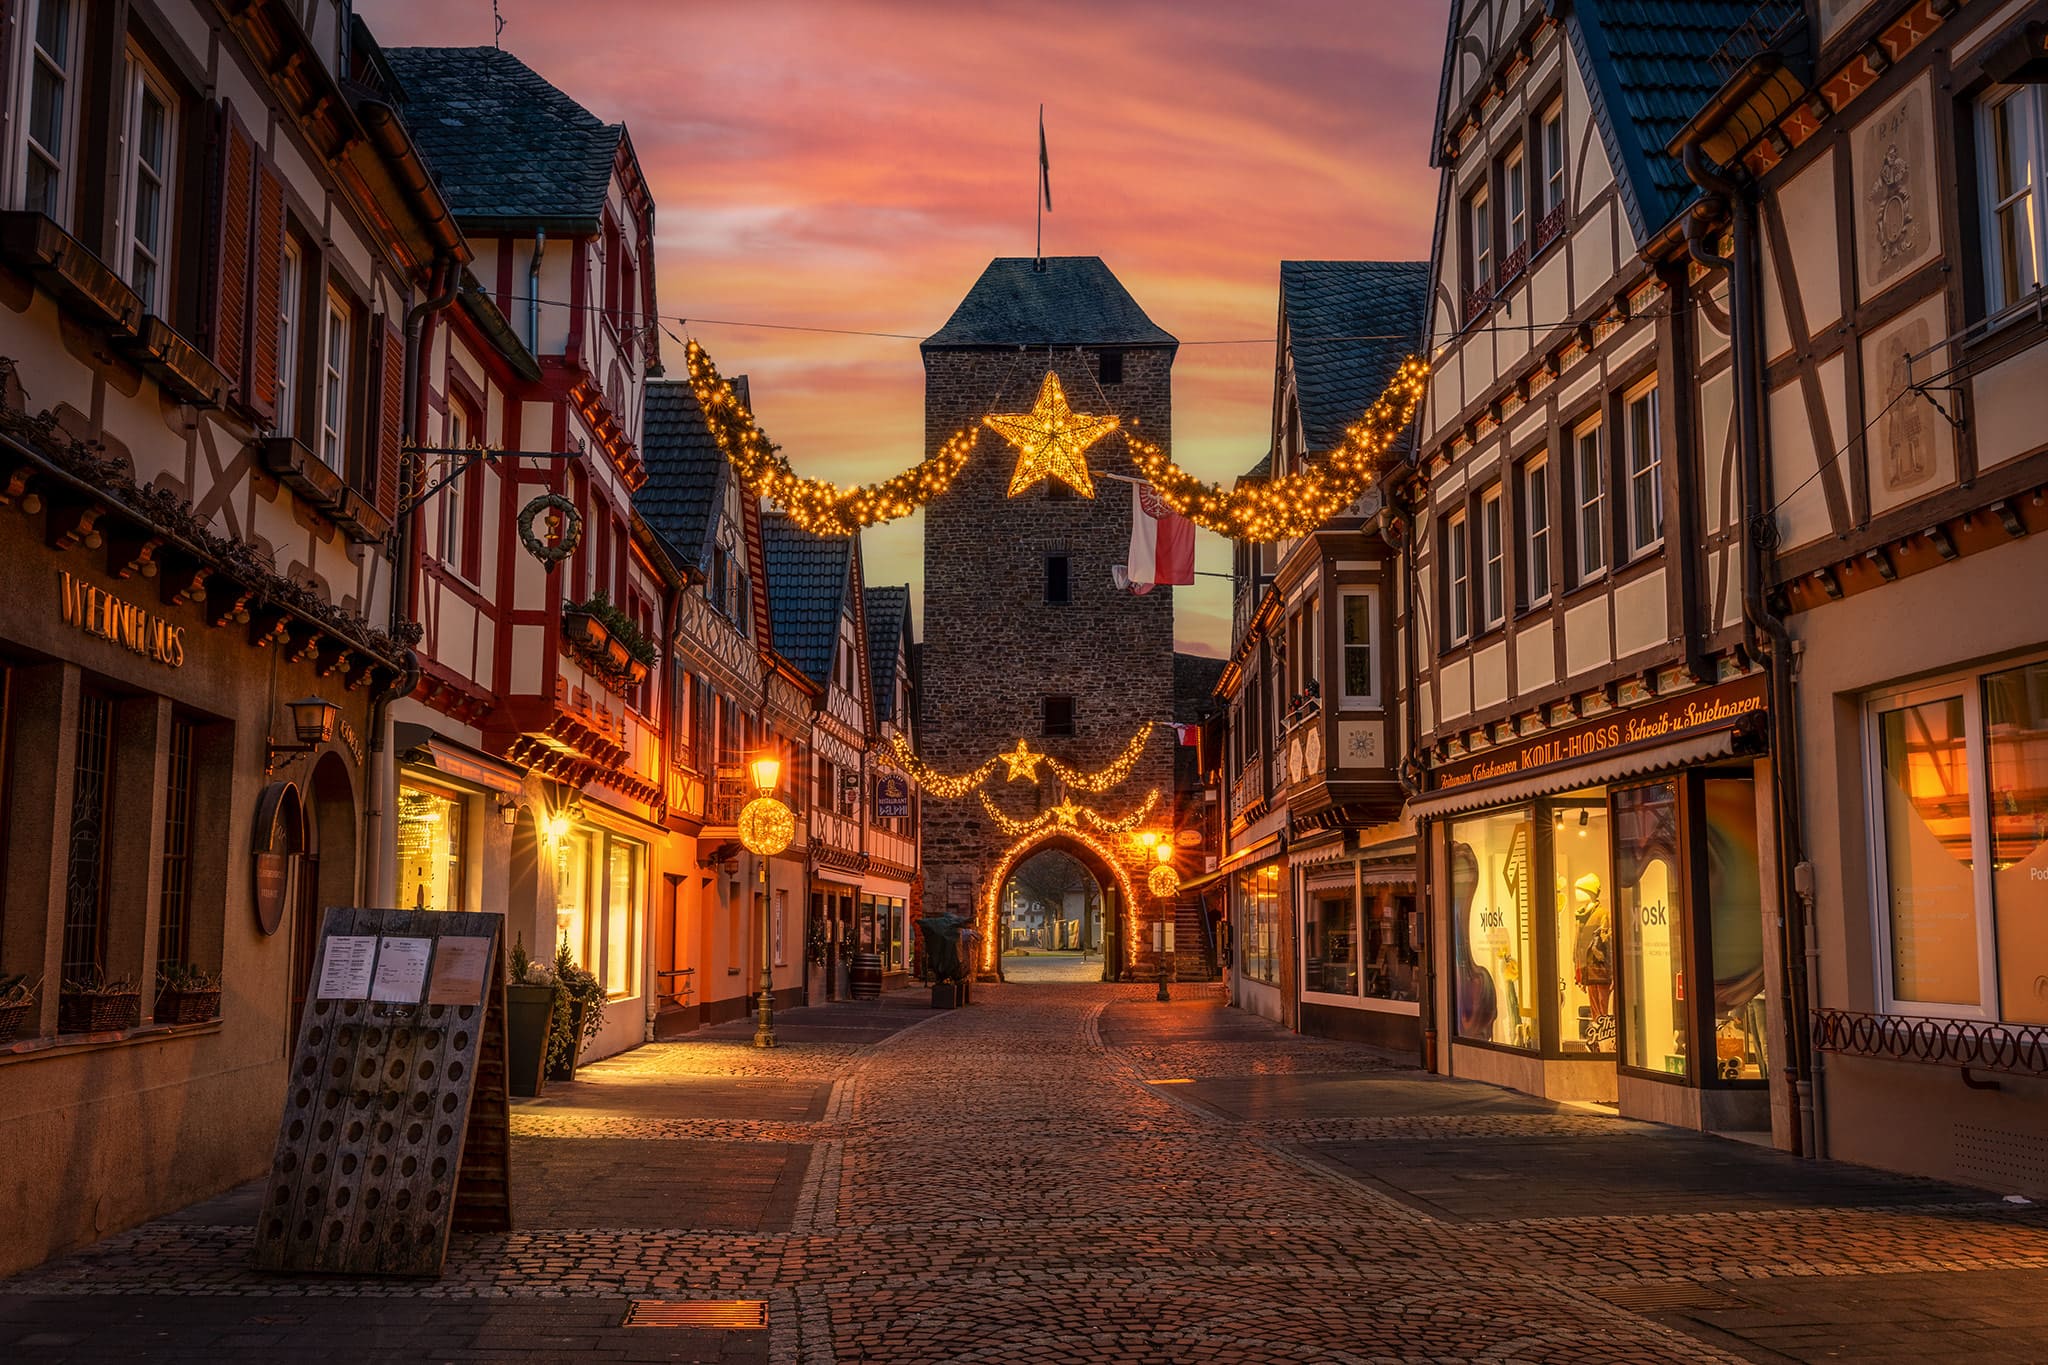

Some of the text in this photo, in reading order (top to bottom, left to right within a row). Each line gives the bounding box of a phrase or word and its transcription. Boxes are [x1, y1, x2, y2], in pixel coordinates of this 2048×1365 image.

[59, 570, 185, 668] WEINHAUS
[1472, 760, 1517, 781] Tabakwaren
[1521, 725, 1619, 769] KOLL-HOSS
[879, 805, 907, 815] DELPHI
